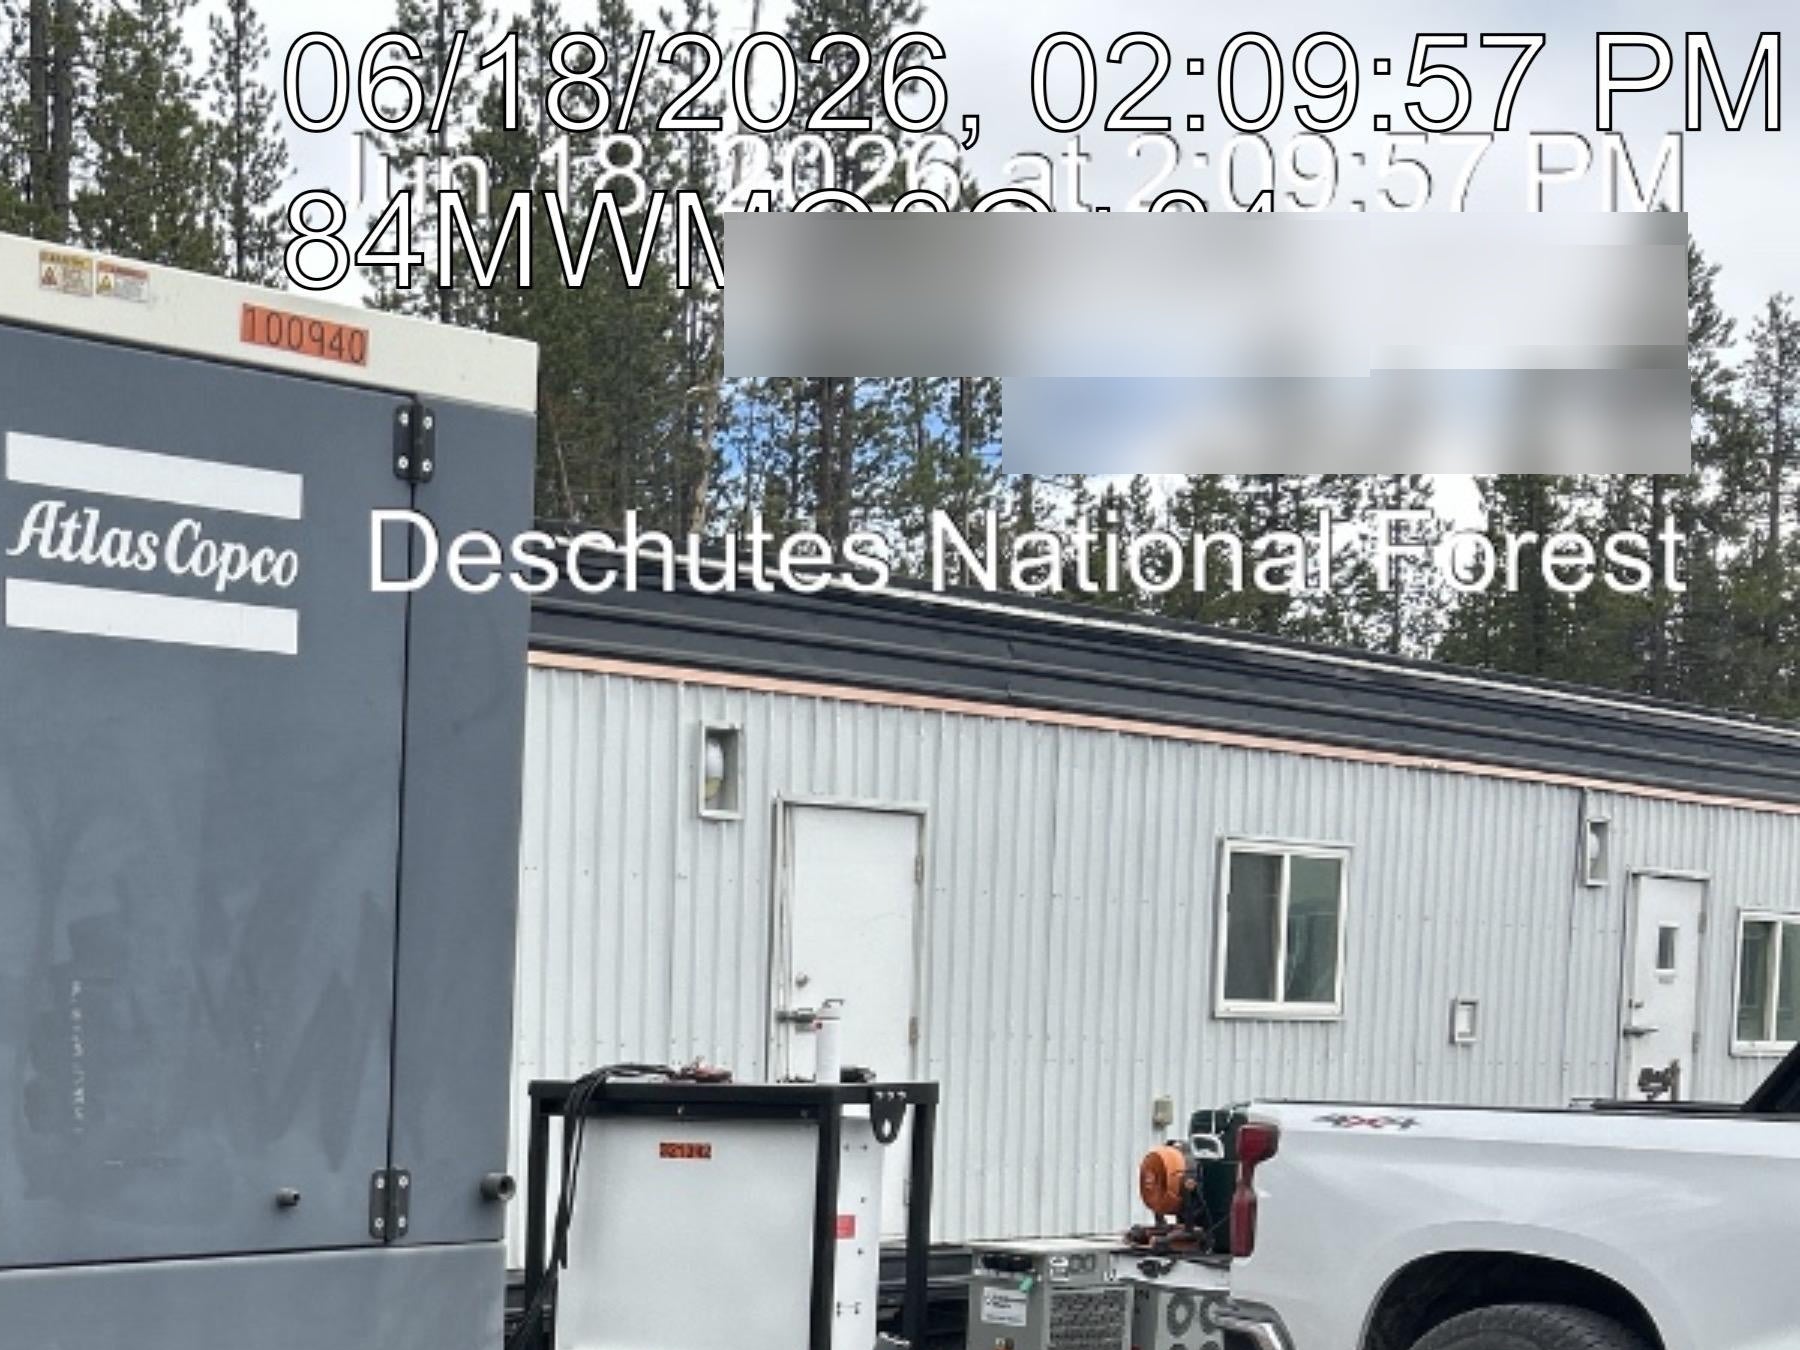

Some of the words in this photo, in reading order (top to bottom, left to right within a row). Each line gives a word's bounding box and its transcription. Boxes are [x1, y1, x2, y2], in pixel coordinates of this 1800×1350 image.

[243, 307, 364, 364] 100940
[6, 499, 160, 572] Atlas
[164, 517, 299, 592] Copco
